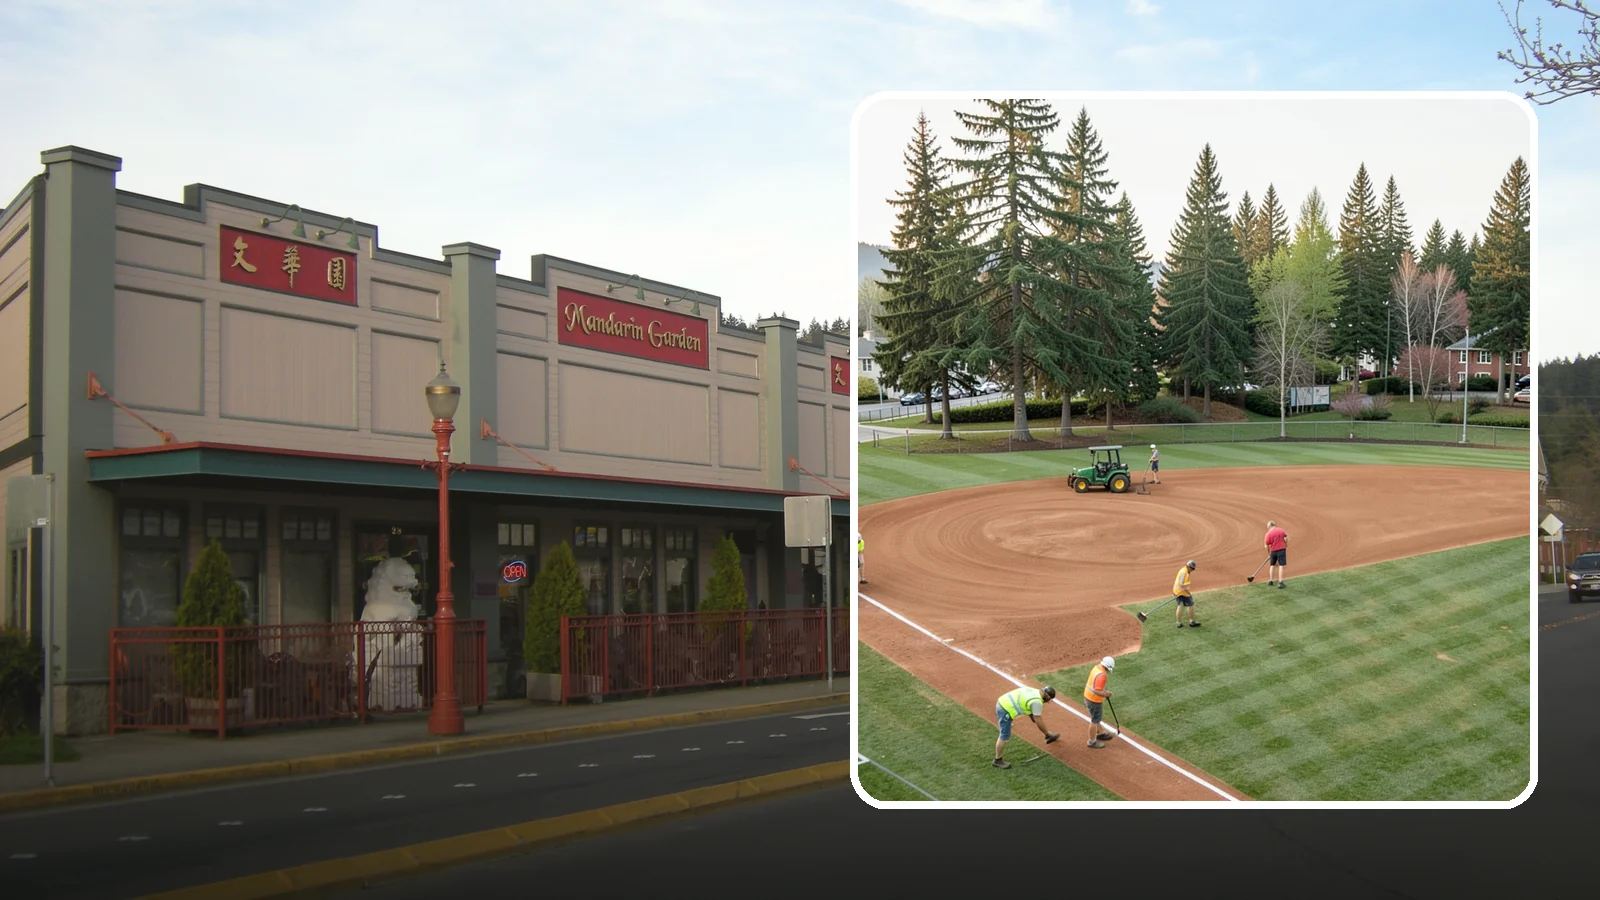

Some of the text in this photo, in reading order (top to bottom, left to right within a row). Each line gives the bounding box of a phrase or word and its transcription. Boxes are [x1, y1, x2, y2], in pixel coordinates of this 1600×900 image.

[231, 236, 346, 290] 文華園
[565, 302, 701, 352] Mandarin Garden
[503, 565, 527, 578] OPEN
